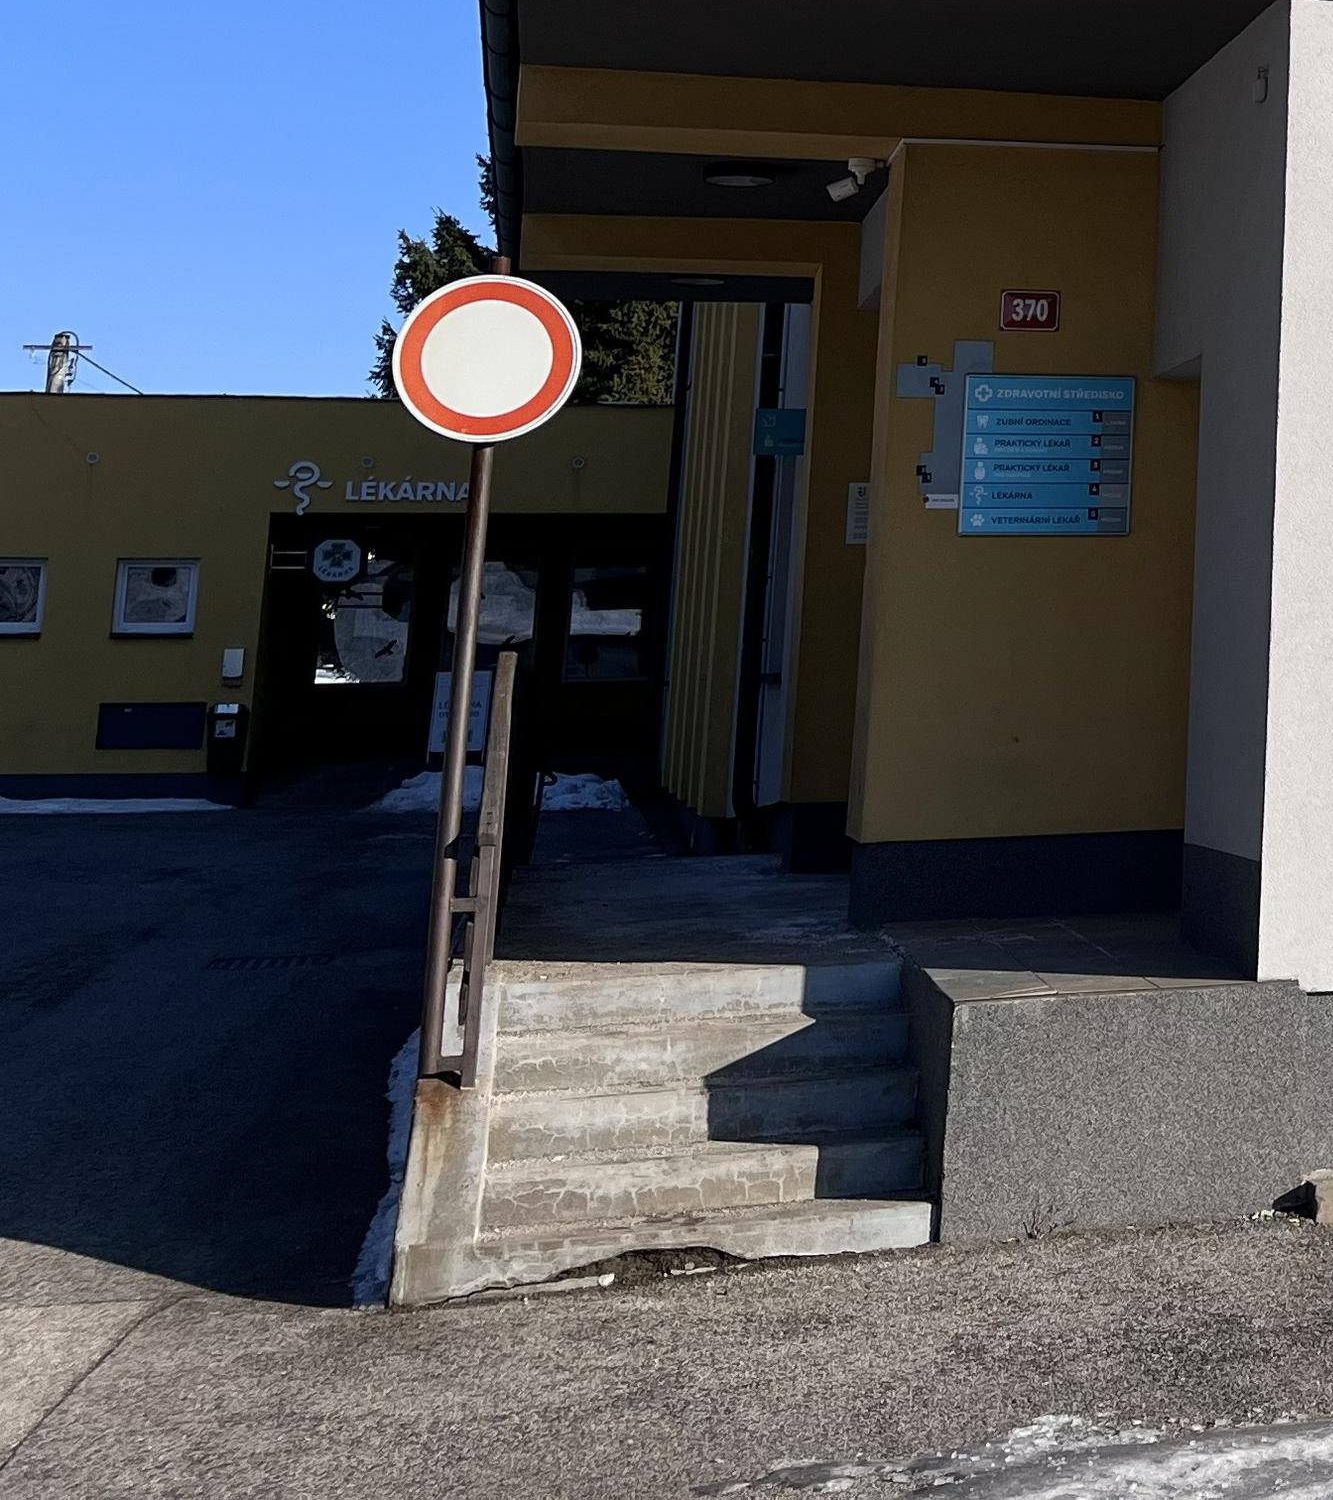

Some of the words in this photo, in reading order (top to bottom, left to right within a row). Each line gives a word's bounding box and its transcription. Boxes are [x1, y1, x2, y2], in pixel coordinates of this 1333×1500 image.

[1011, 298, 1049, 323] 370
[996, 388, 1061, 399] ZDRAVOTNÍ
[1063, 388, 1125, 400] STŘEDISKO
[1025, 418, 1072, 427] ORDINACE
[991, 515, 1050, 525] VETERINÁRNÍ
